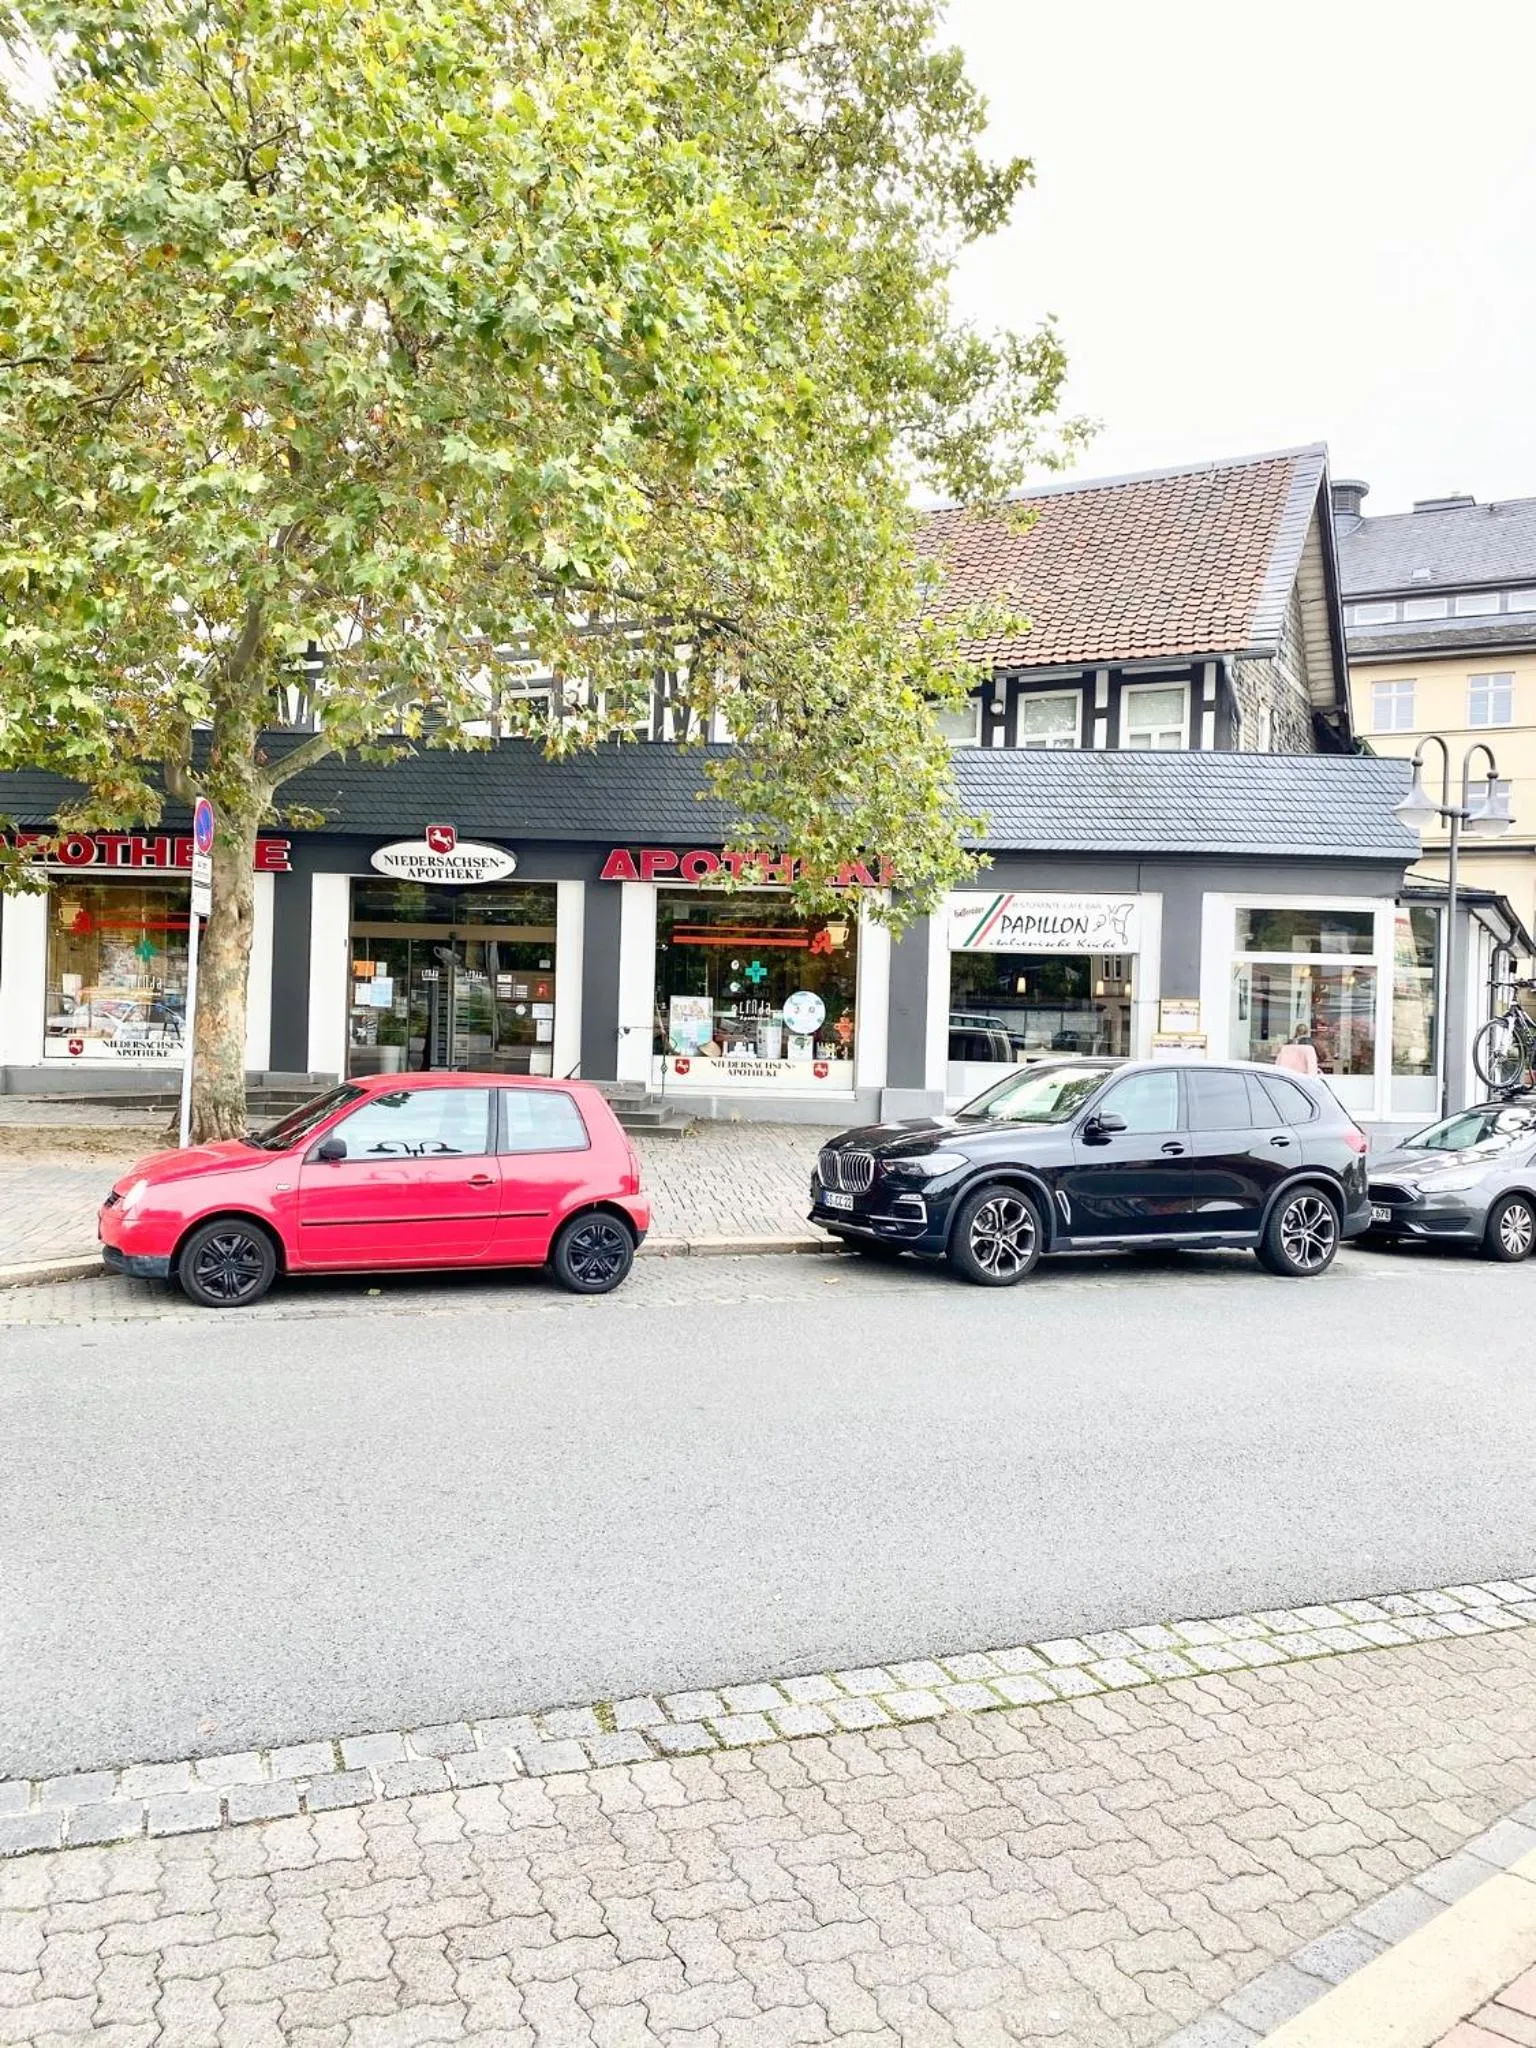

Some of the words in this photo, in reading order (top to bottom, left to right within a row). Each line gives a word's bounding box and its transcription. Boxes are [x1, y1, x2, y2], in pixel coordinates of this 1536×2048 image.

[0, 833, 292, 872] POTHEE
[384, 854, 506, 868] NIEDERSACHSEN-
[407, 868, 484, 880] APOTHEKE
[1001, 914, 1089, 934] PAPILLON
[116, 1049, 169, 1057] APOTHEKE
[727, 1068, 777, 1077] APOTHEKE
